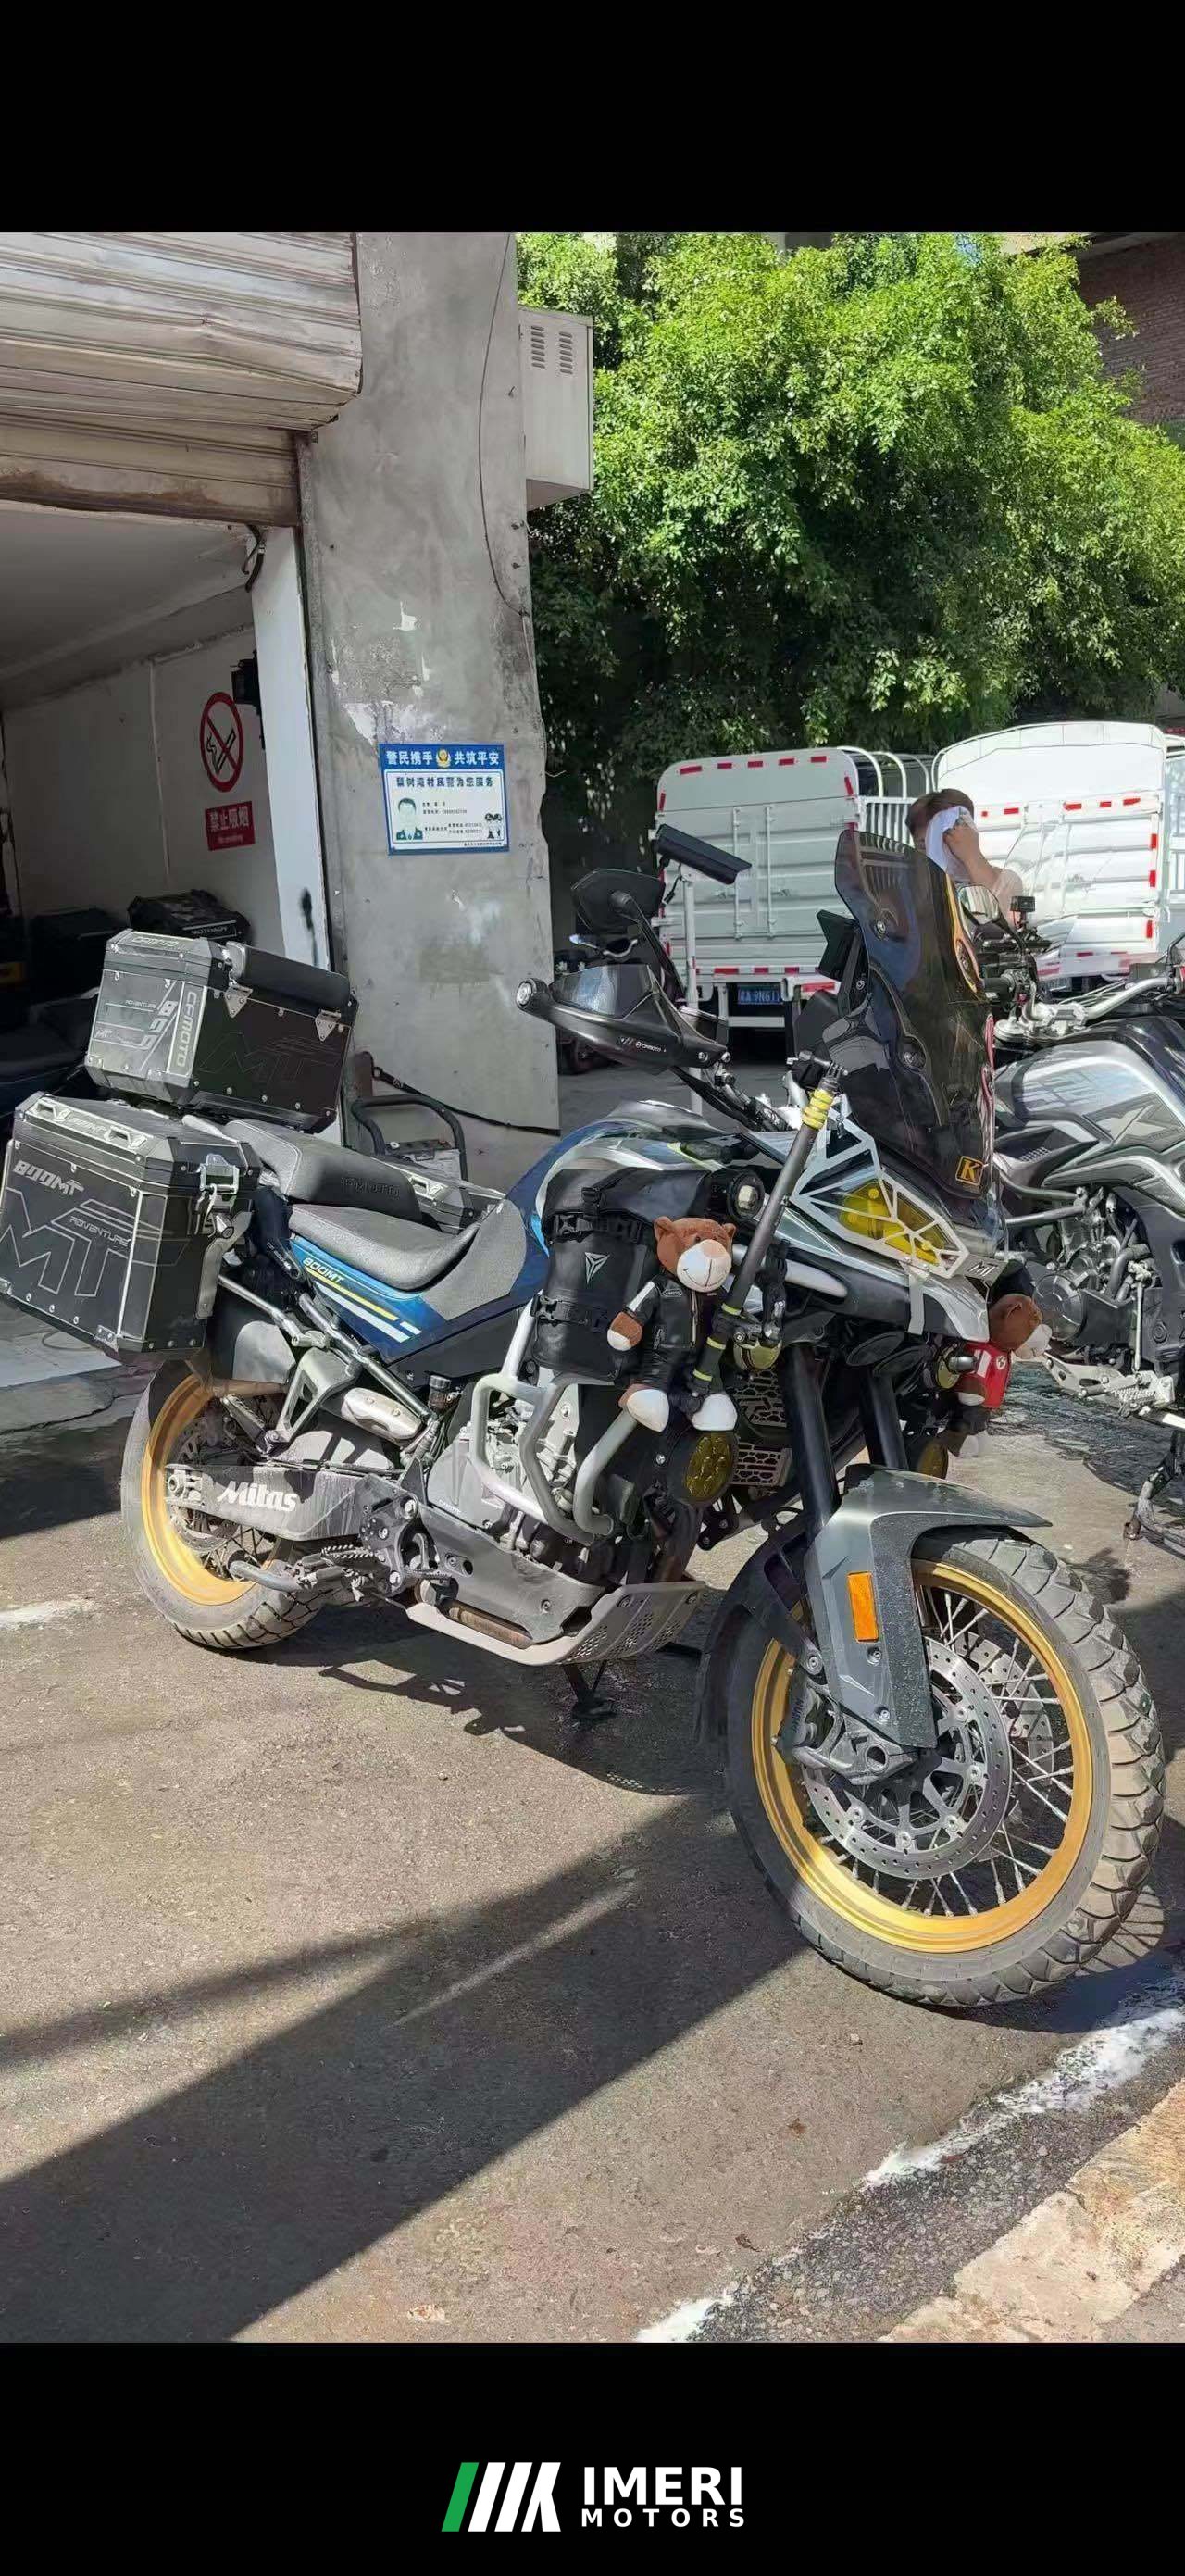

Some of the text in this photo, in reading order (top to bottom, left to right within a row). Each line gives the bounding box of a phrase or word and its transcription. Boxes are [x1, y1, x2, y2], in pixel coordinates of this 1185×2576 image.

[386, 750, 500, 766] 警民携手 共筑平安
[210, 806, 250, 832] 禁止吸烟
[176, 991, 198, 1068] CFMOTO
[12, 1159, 85, 1196] 800MT
[960, 1158, 981, 1182] K
[69, 1216, 132, 1247] ADVENTURE
[302, 1257, 345, 1285] 800MT
[216, 1480, 297, 1512] Mitas
